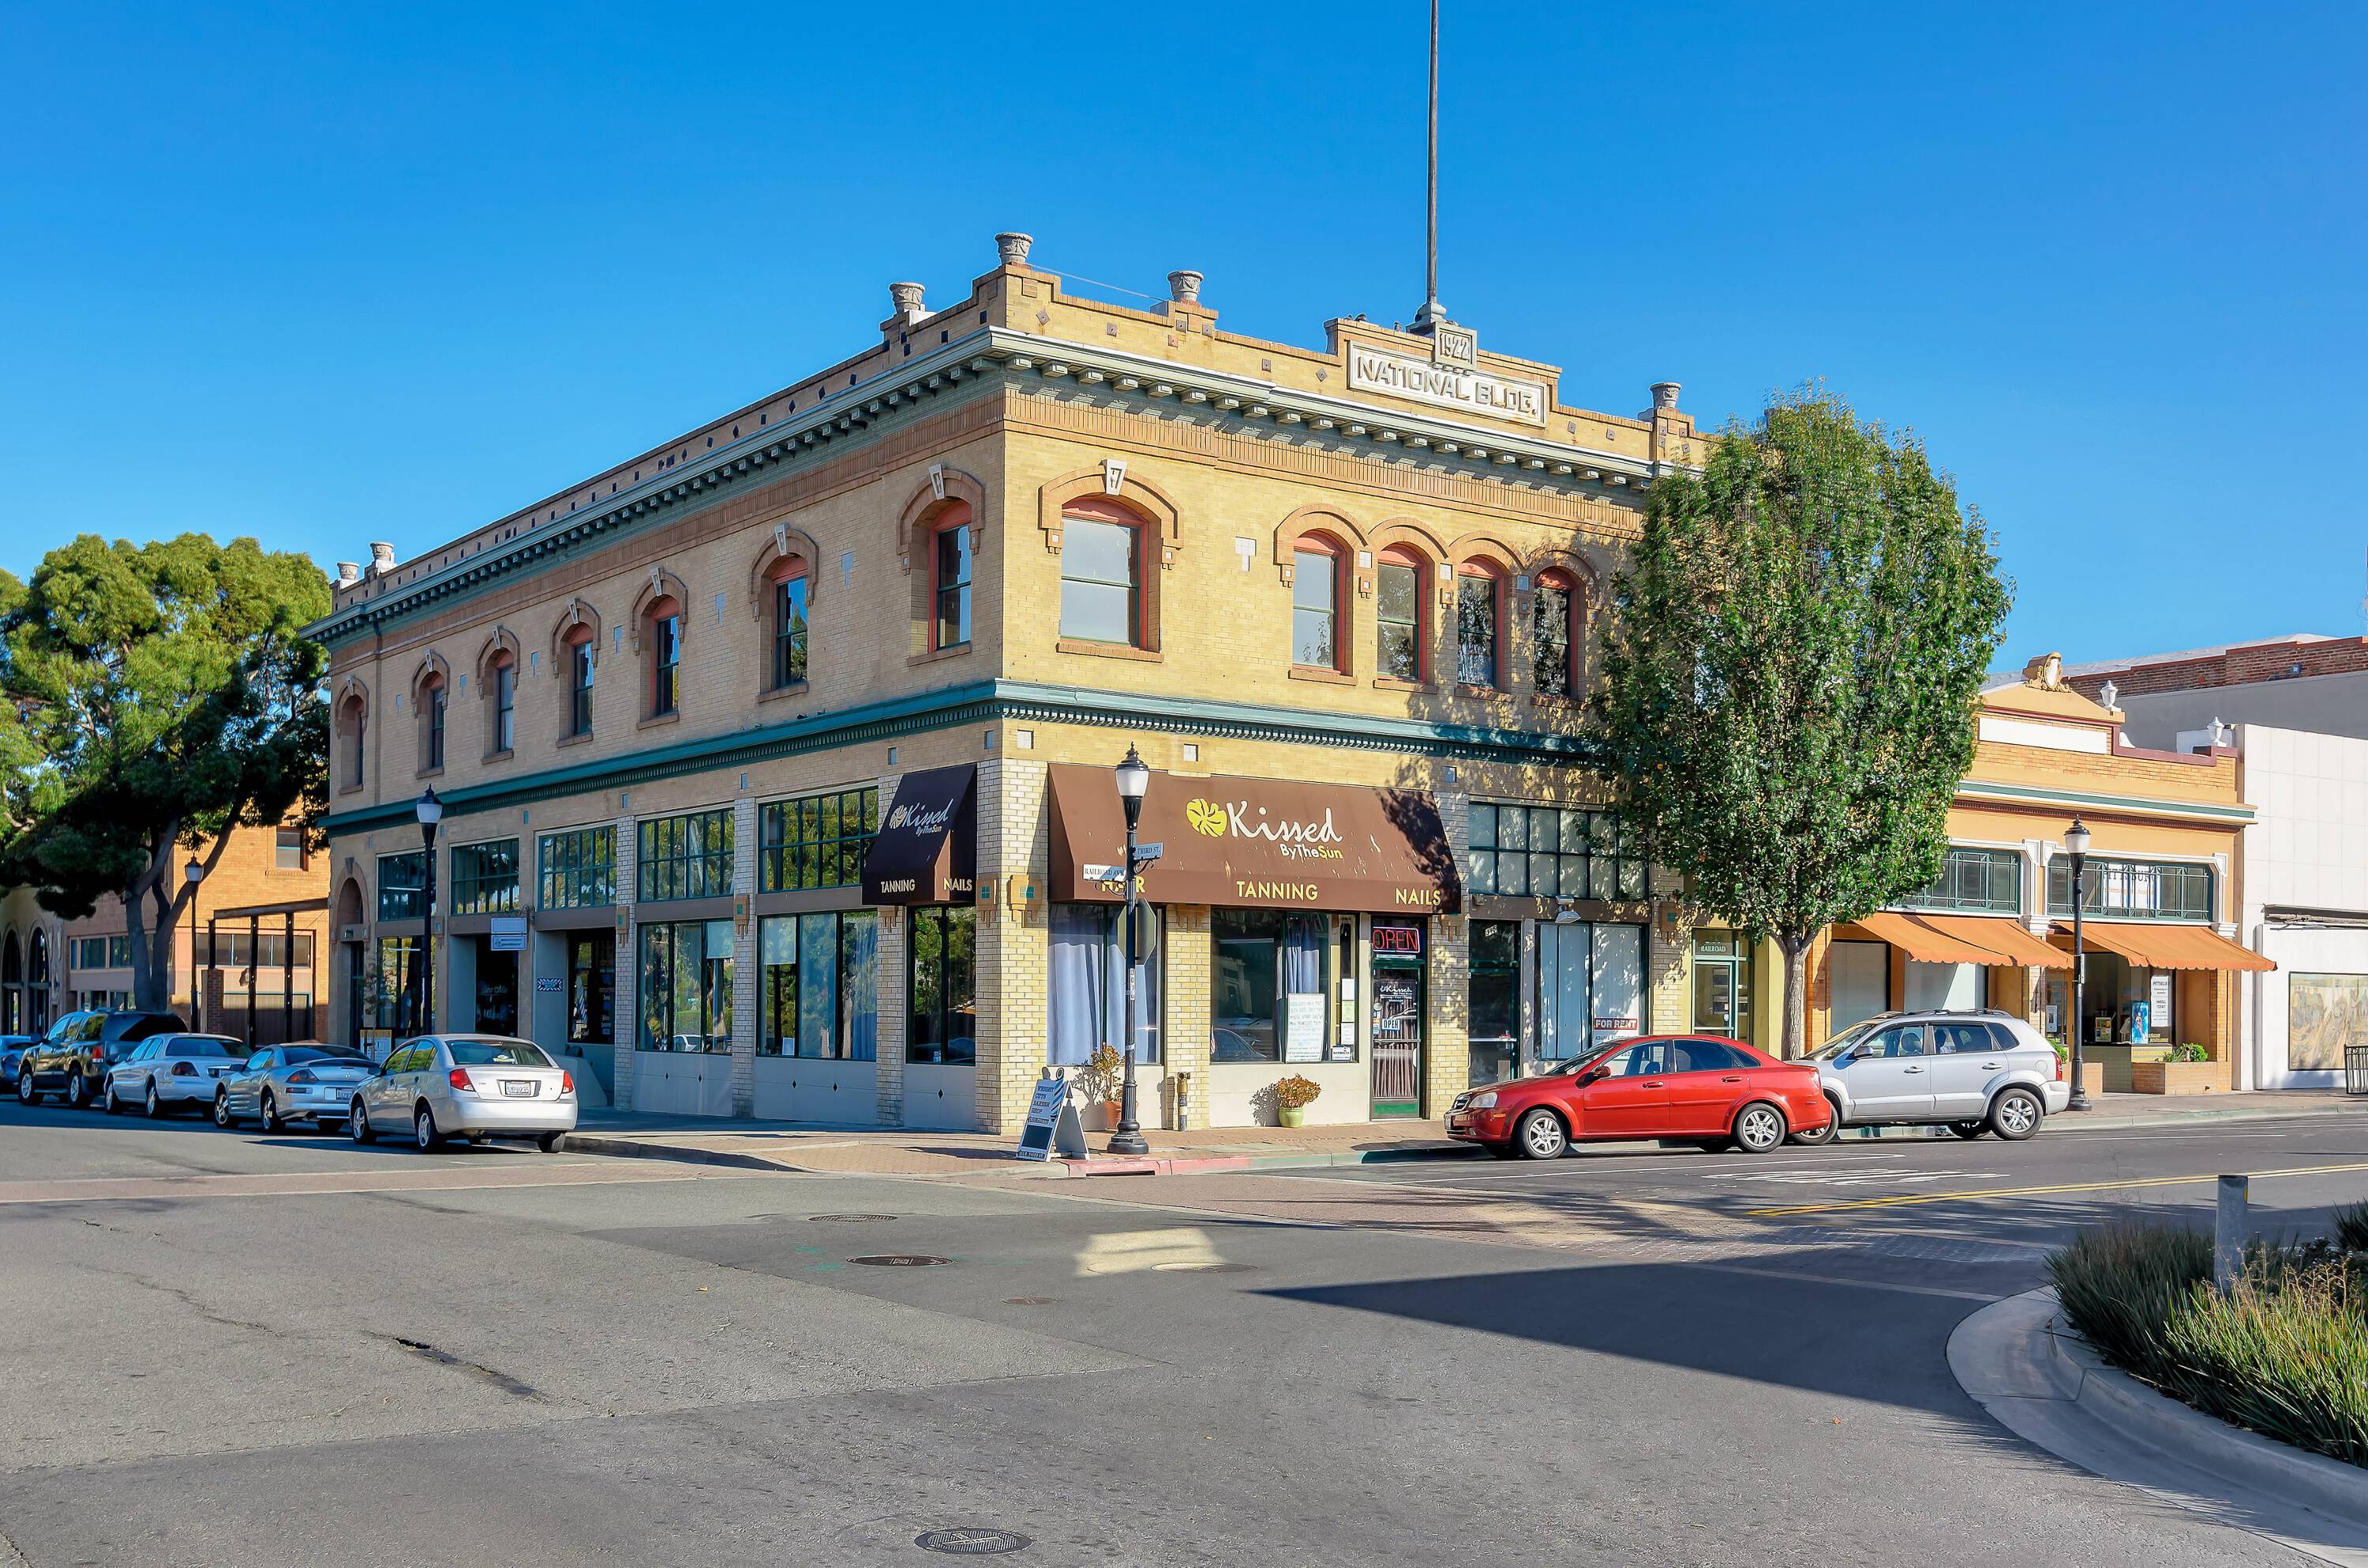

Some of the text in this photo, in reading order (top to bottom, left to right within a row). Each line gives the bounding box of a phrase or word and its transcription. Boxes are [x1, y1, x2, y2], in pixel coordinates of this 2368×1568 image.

[1439, 333, 1471, 361] 1922
[1357, 356, 1538, 416] NATIONAL BLDG.
[901, 798, 954, 828] Kissed
[1225, 800, 1343, 843] Kissed
[880, 879, 916, 893] TANNING
[943, 878, 972, 892] NAILS
[1236, 881, 1318, 901] TANNING
[1395, 887, 1441, 906] NAILS
[1373, 930, 1418, 950] OPEN
[1384, 1020, 1399, 1029] OPEN
[1595, 1019, 1637, 1028] FOR RENT
